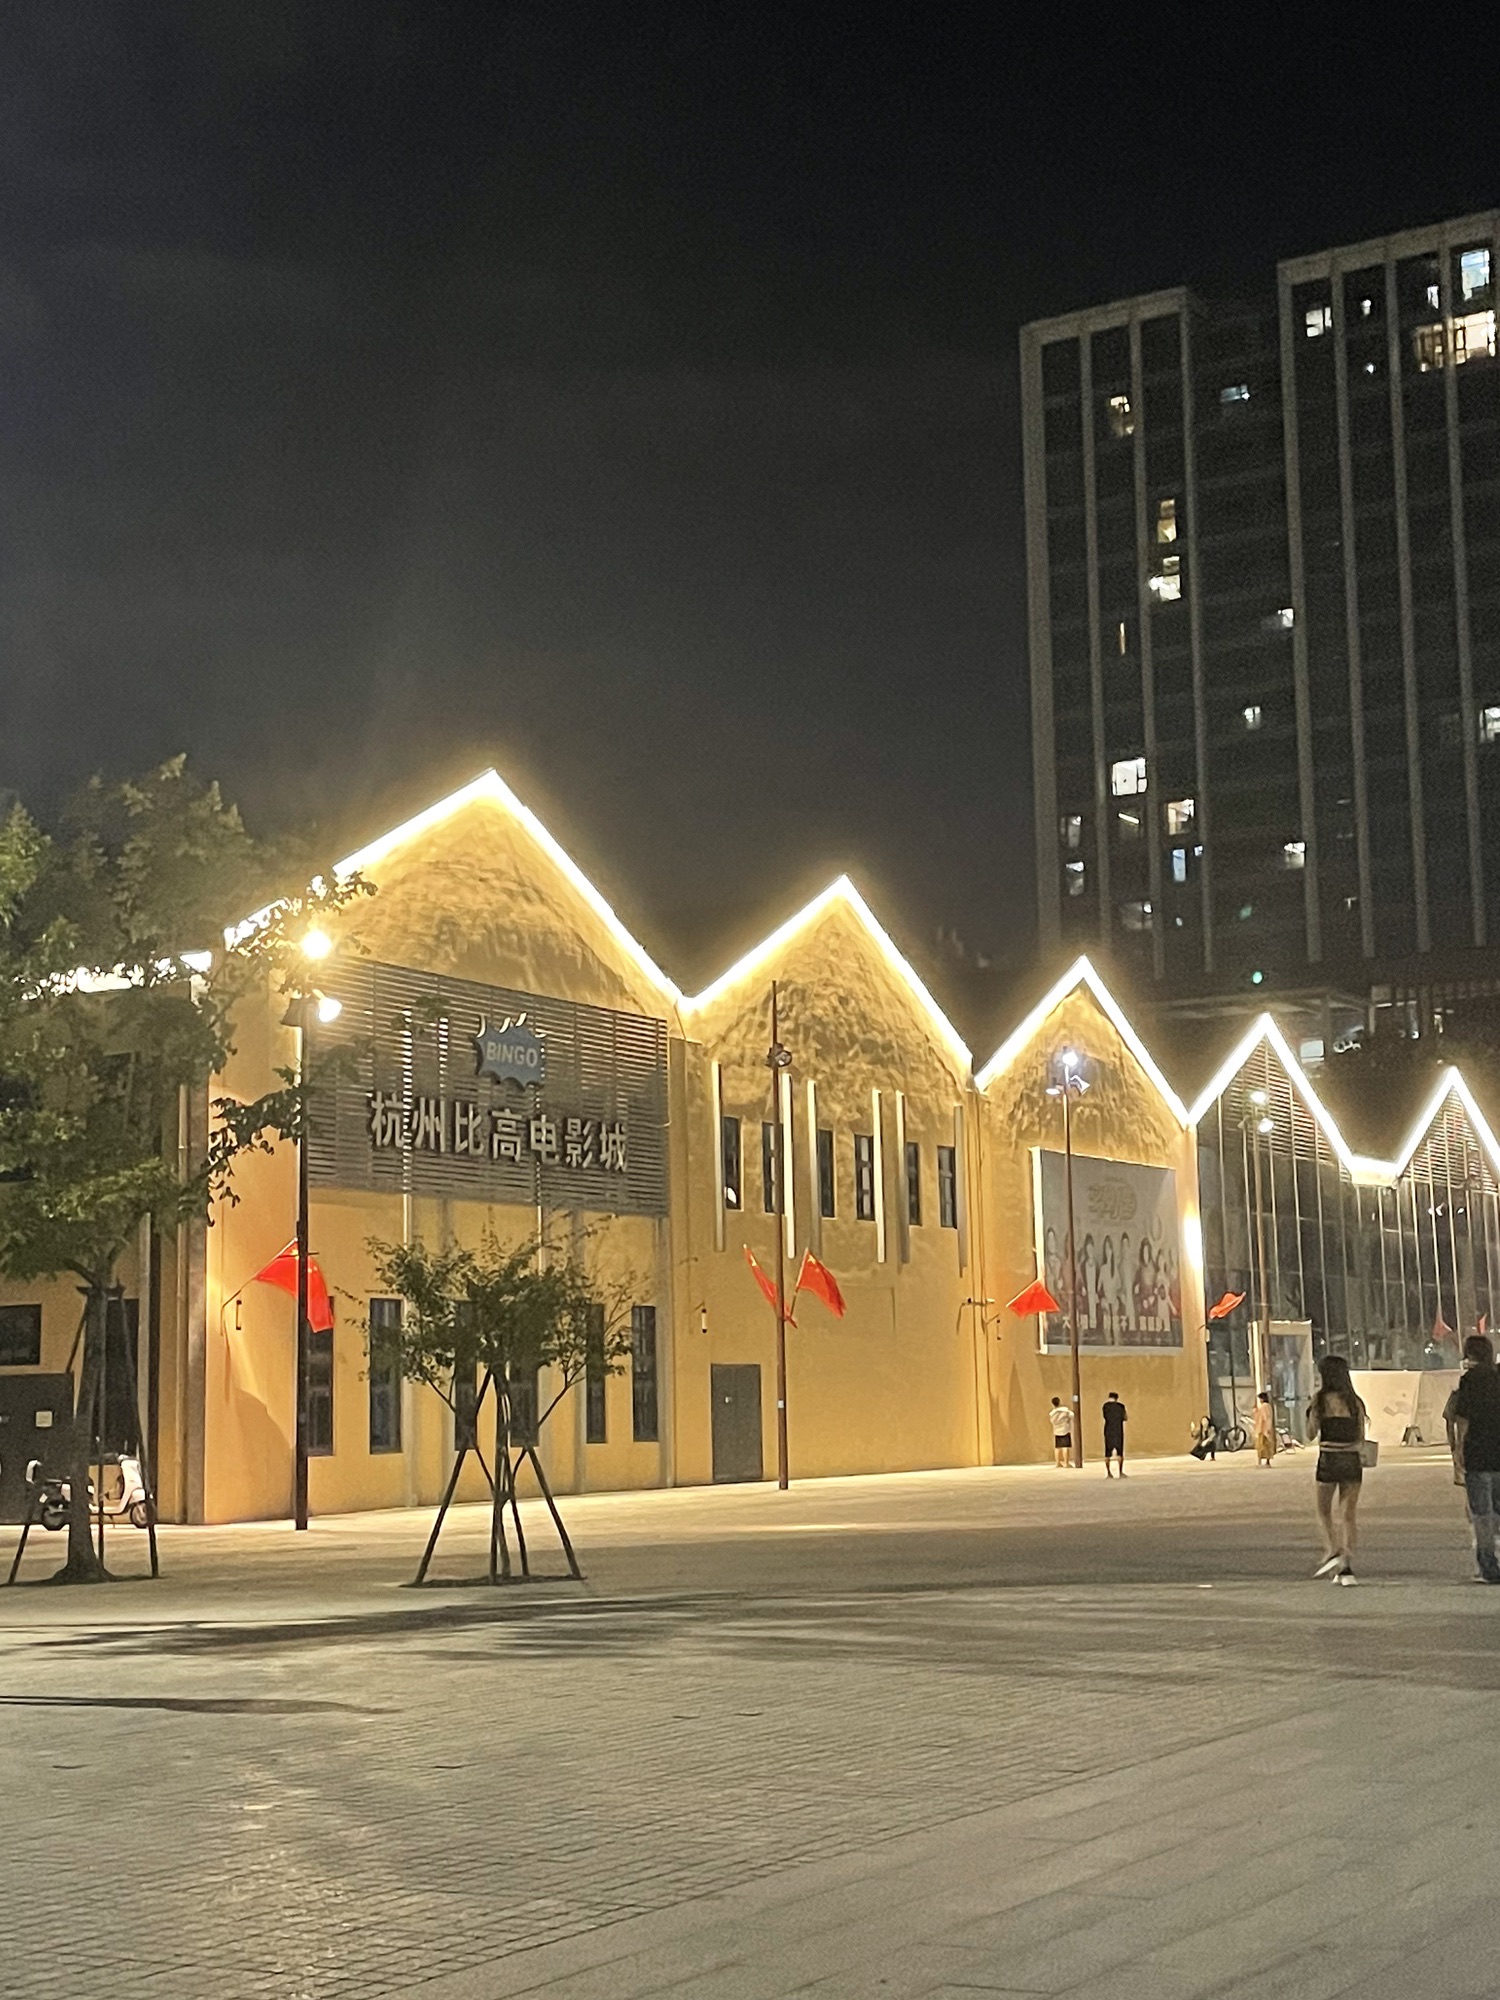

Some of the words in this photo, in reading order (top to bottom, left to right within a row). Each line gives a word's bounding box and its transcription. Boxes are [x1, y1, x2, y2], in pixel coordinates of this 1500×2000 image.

[486, 1041, 539, 1068] BINGO
[371, 1091, 627, 1172] 杭州比高电影城
